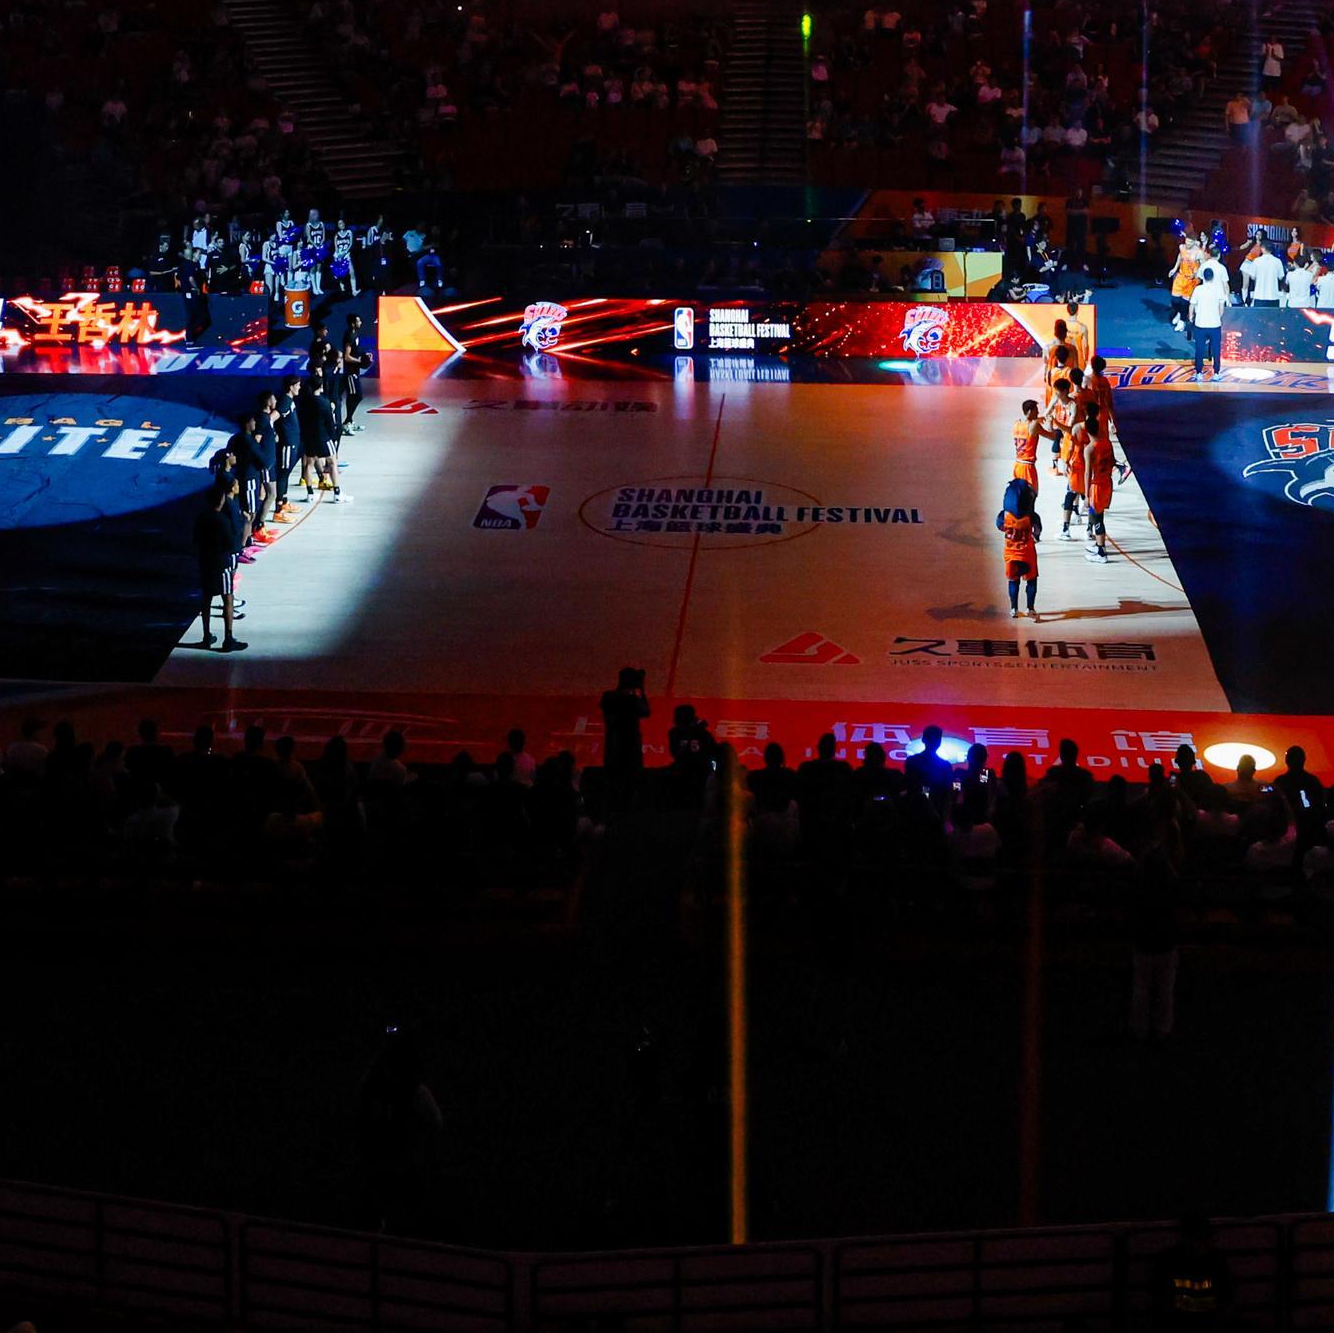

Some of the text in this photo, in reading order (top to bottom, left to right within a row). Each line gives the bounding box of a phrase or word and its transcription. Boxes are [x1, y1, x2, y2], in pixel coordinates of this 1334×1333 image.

[34, 302, 158, 345] 王哲林
[709, 308, 749, 323] SHANGHAI
[709, 323, 790, 338] BASKETBALL FESTIVAL
[156, 353, 310, 373] UNIT
[616, 488, 763, 504] SHANGHAI
[611, 504, 925, 525] BASKETBALL FESTIVAL
[889, 636, 1157, 663] 久事体育
